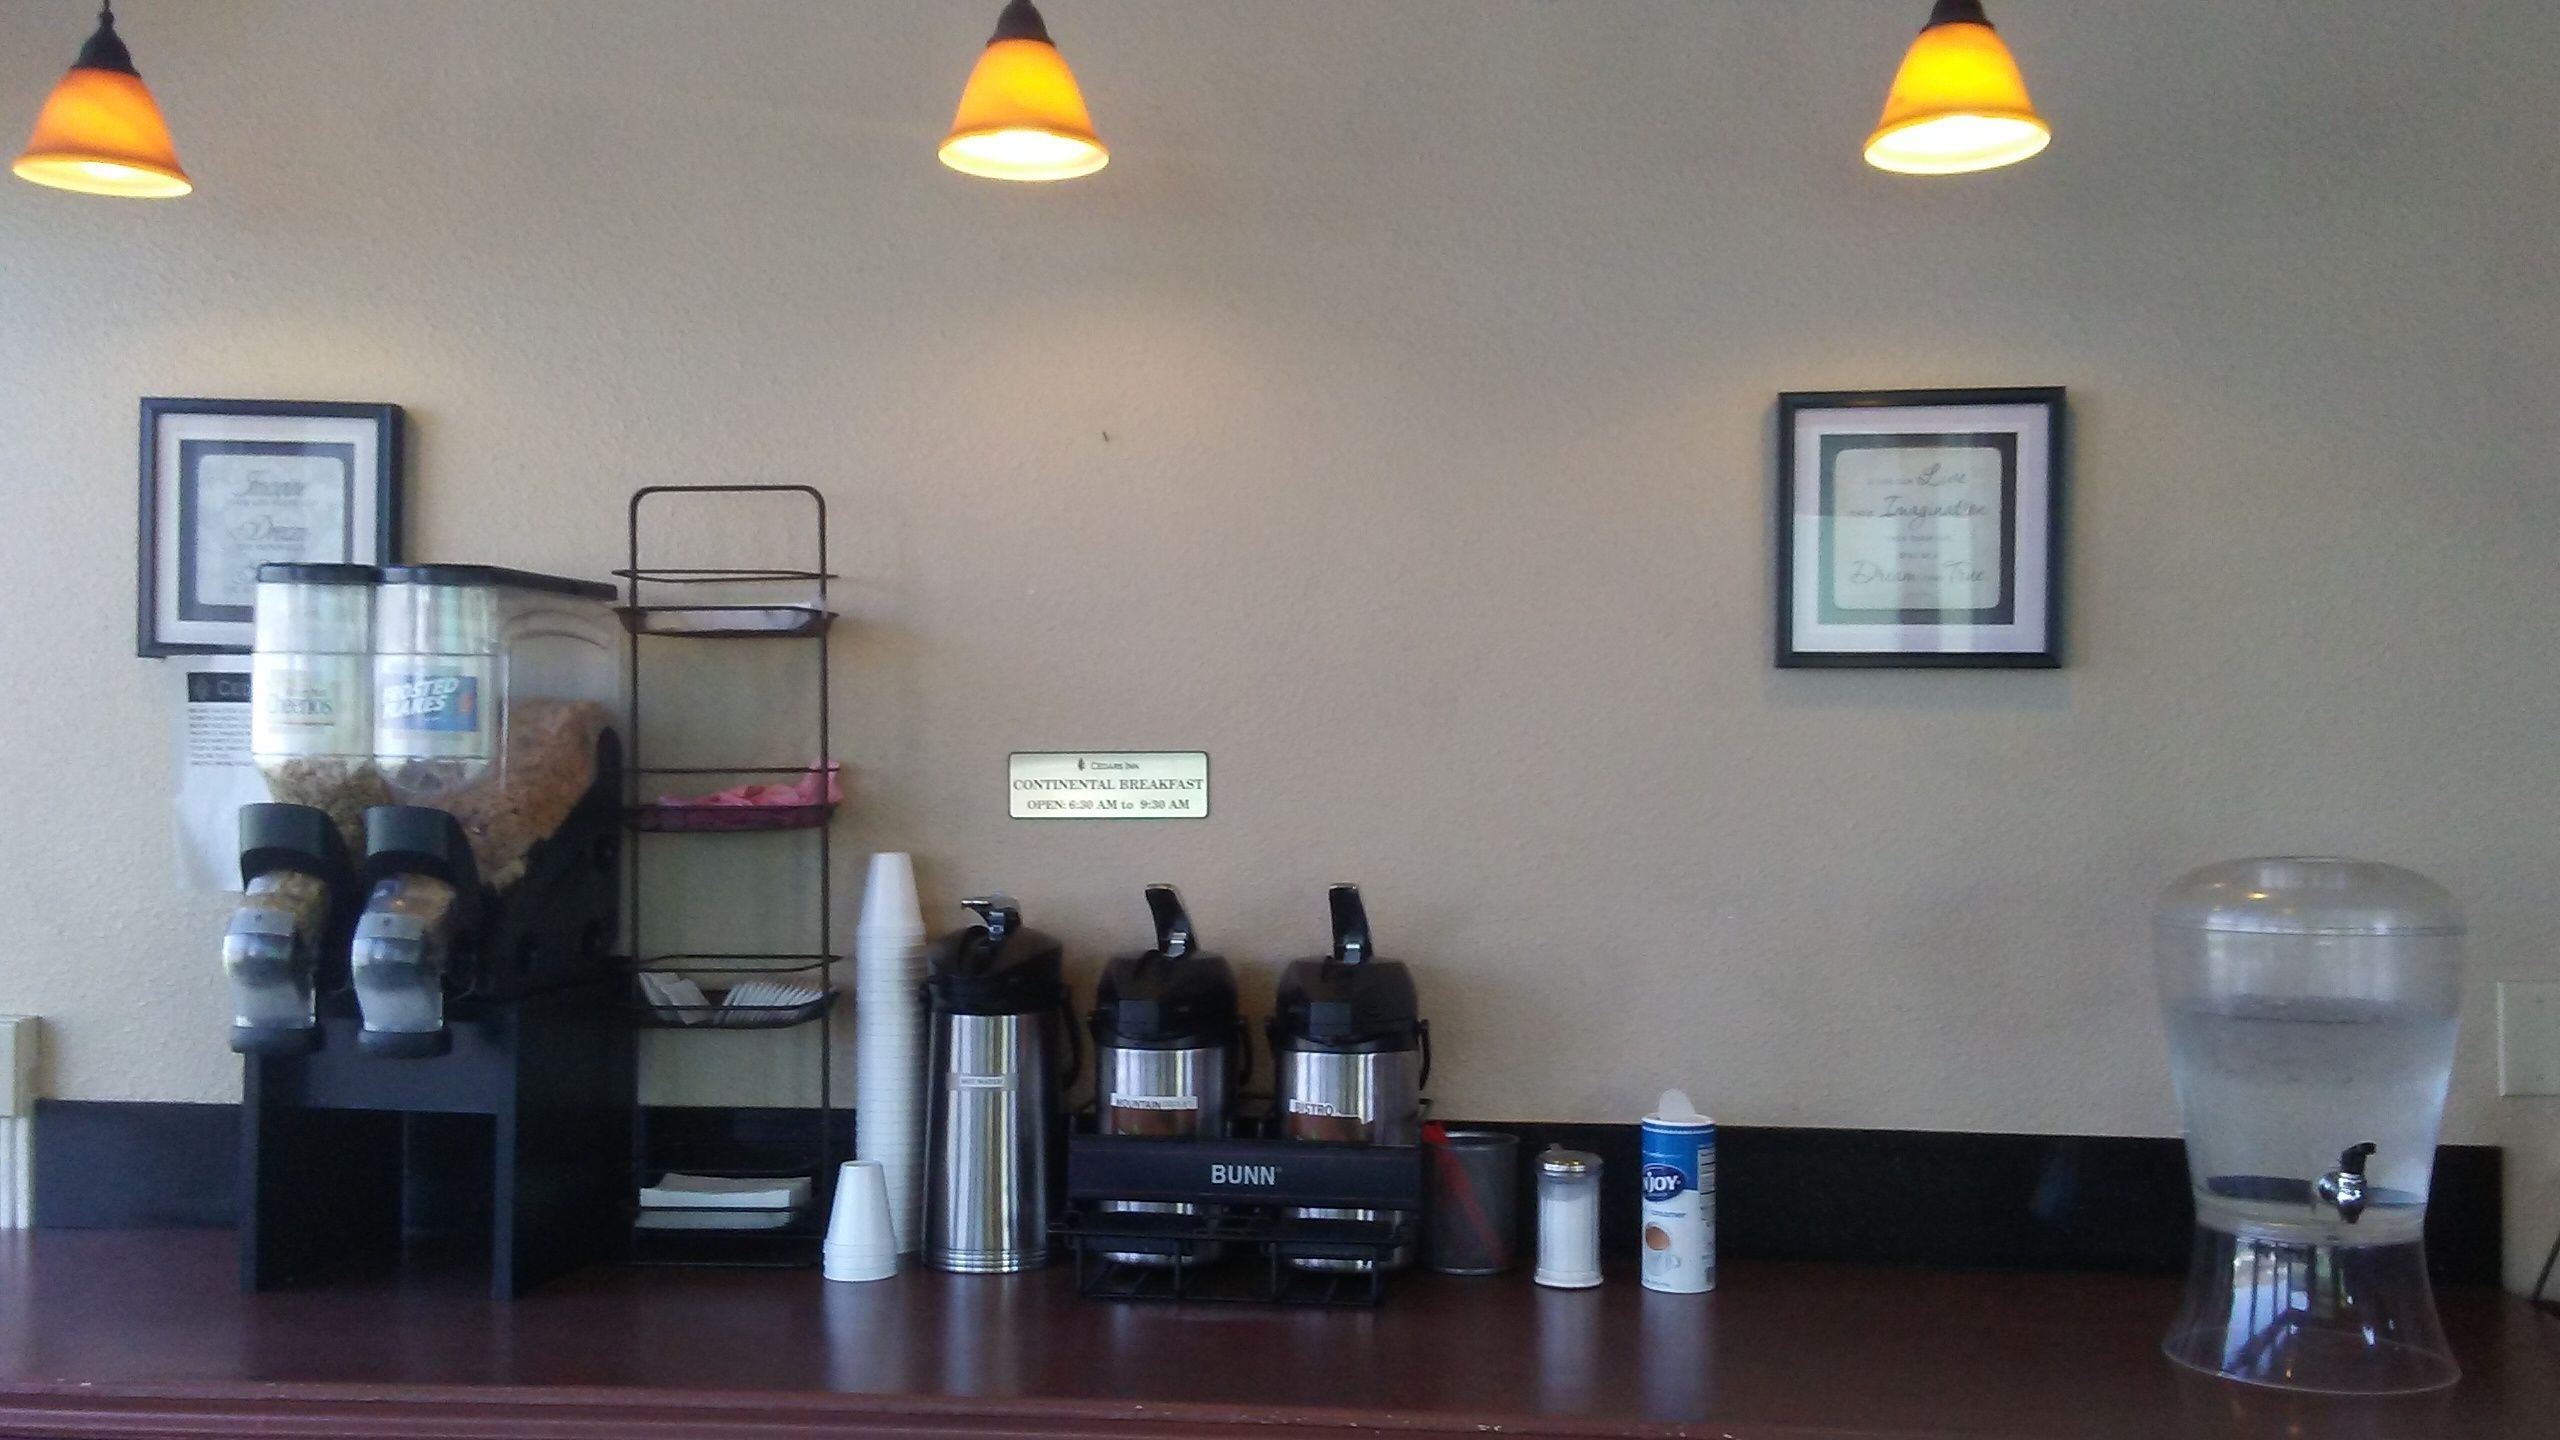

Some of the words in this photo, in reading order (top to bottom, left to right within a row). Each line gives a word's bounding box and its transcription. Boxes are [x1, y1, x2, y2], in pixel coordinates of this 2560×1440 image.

[1013, 779, 1115, 790] CONTINENTAL
[1119, 779, 1204, 790] BREAKFAST
[1068, 799, 1094, 810] 6:30
[1096, 799, 1117, 810] AM
[1121, 801, 1134, 810] to
[1140, 799, 1166, 810] 9:30
[1168, 799, 1190, 810] AM
[1211, 1164, 1276, 1185] BUNN
